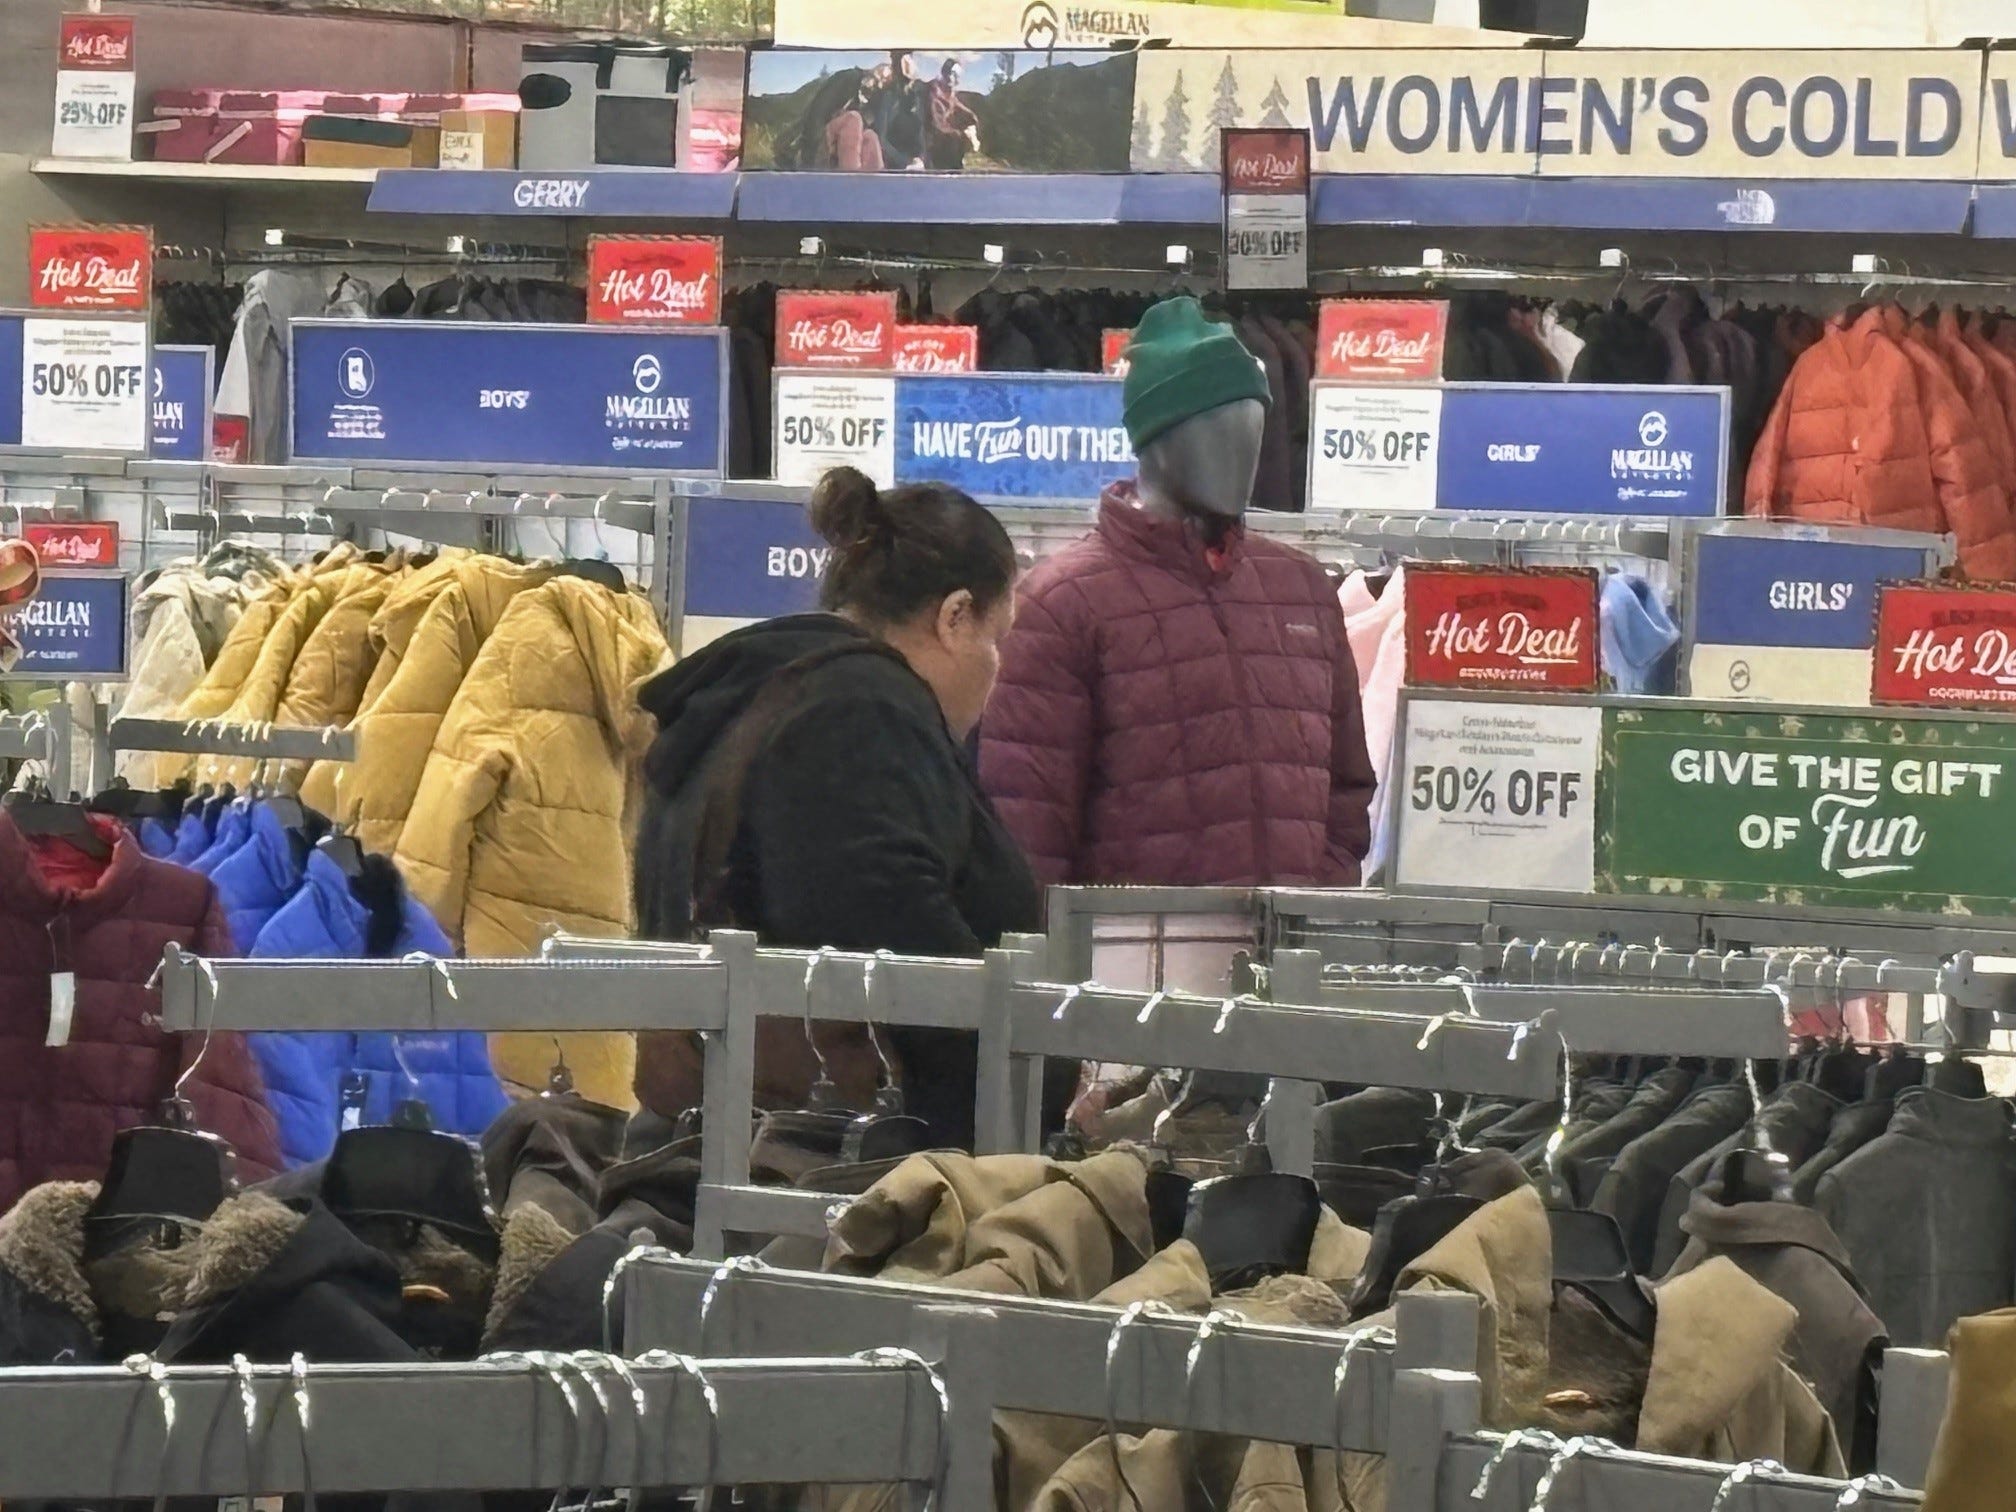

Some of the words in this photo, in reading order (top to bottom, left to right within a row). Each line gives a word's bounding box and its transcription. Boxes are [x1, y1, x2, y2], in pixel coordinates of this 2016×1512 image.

[1065, 8, 1149, 35] MAGELLAN
[97, 102, 128, 125] OFF
[1305, 75, 1710, 157] WOMEN'S
[1732, 75, 1963, 158] COLD
[513, 179, 590, 208] GERRY
[1270, 230, 1303, 257] OFF
[40, 257, 83, 292] Hot
[84, 256, 141, 293] Deal
[600, 268, 646, 305] Hot
[647, 268, 710, 309] Deal
[788, 320, 828, 351] Hot
[831, 319, 884, 352] Deal
[1331, 330, 1371, 362] Hot
[1371, 329, 1431, 363] Deal
[32, 363, 89, 397] 50%
[95, 364, 142, 398] OFF
[605, 394, 691, 419] MAGELLAN
[784, 415, 836, 447] 50%
[841, 416, 886, 448] OFF
[913, 421, 973, 458] HAVE
[974, 416, 1024, 464] Fun
[1025, 425, 1073, 462] OUT
[1323, 429, 1377, 461] 50%
[1383, 431, 1431, 462] OFF
[767, 546, 831, 578] BOY
[1768, 580, 1853, 612] GIRLS'
[1425, 611, 1491, 660] Hot
[1495, 611, 1581, 663] Deal
[1892, 629, 1966, 680] Hot
[1969, 629, 2016, 684] De
[1670, 748, 1778, 786] GIVE
[1787, 753, 1882, 792] THE
[1890, 759, 2002, 798] GIFT
[1411, 765, 1496, 815] 50%
[1508, 768, 1582, 819] OFF
[1738, 814, 1801, 850] OF
[1811, 793, 1927, 879] Fun
